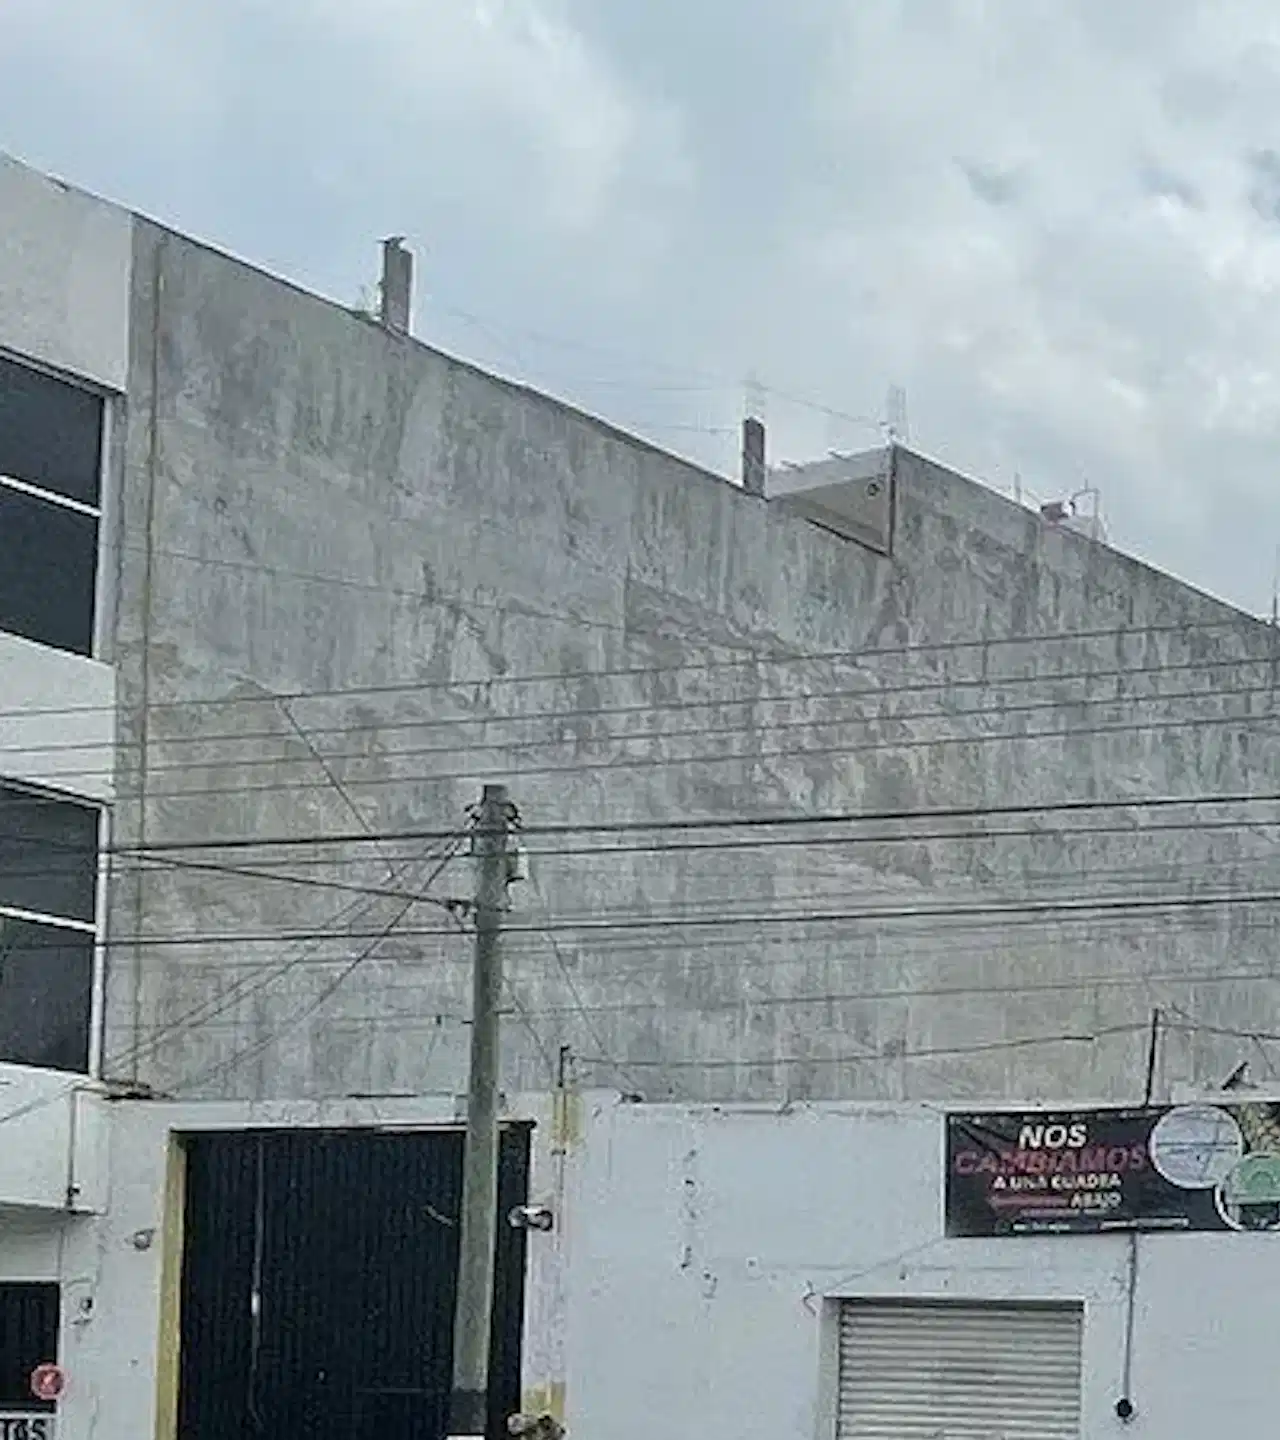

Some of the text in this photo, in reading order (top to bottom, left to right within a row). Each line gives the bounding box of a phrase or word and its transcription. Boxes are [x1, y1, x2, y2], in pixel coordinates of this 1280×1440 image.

[1018, 1124, 1088, 1150] NOS
[954, 1143, 1147, 1175] CAMBIAMOS
[993, 1173, 1122, 1190] A UNA CUADRA
